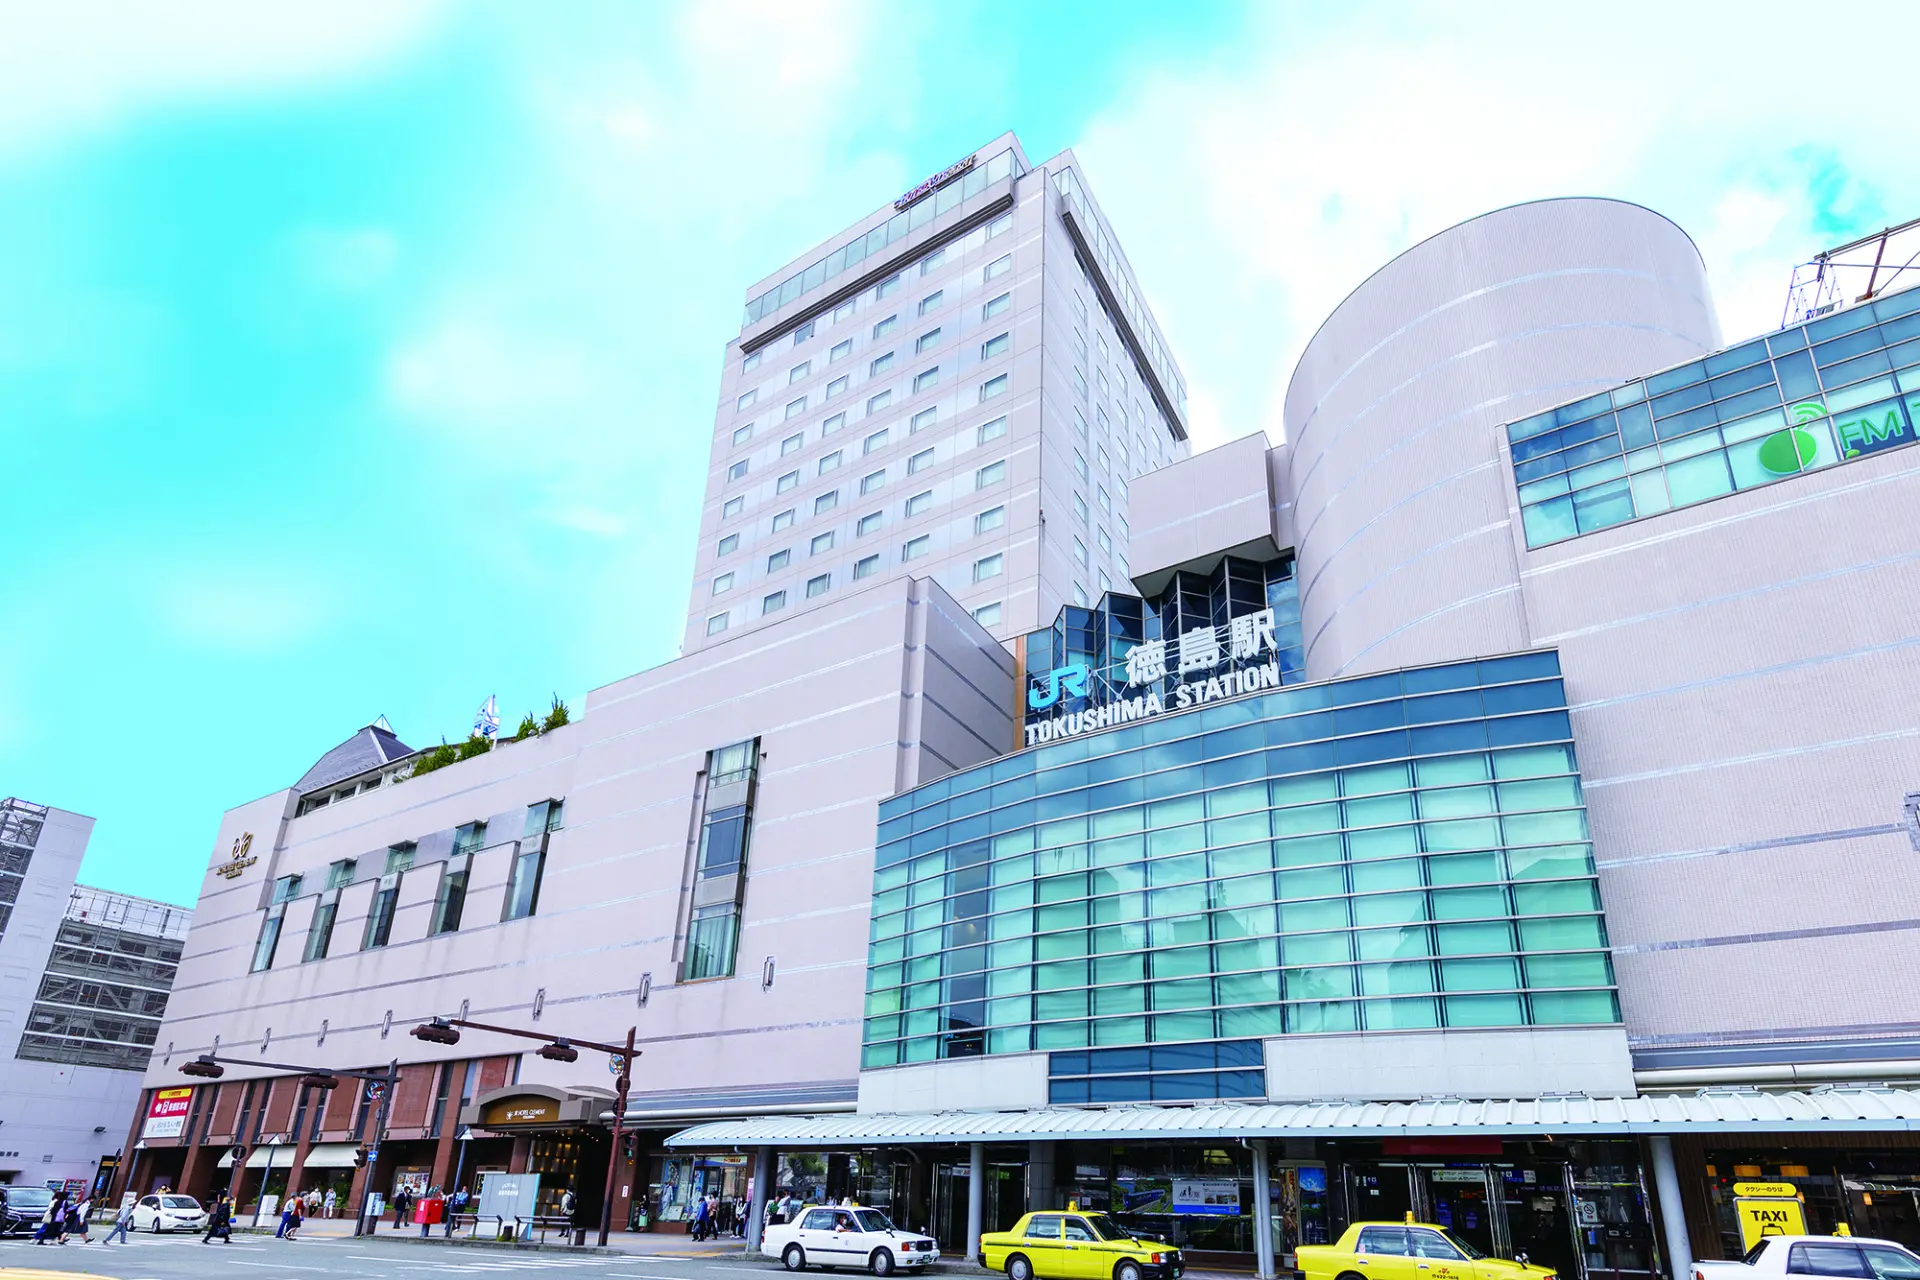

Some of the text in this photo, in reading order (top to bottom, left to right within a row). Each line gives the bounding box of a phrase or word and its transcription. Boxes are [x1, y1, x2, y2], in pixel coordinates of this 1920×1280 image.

[1839, 410, 1902, 449] FM
[1125, 608, 1279, 688] 徳島駅
[1025, 662, 1281, 746] TOKUSHIMA STATION
[1029, 662, 1089, 709] JR
[1750, 1210, 1788, 1222] TAXI
